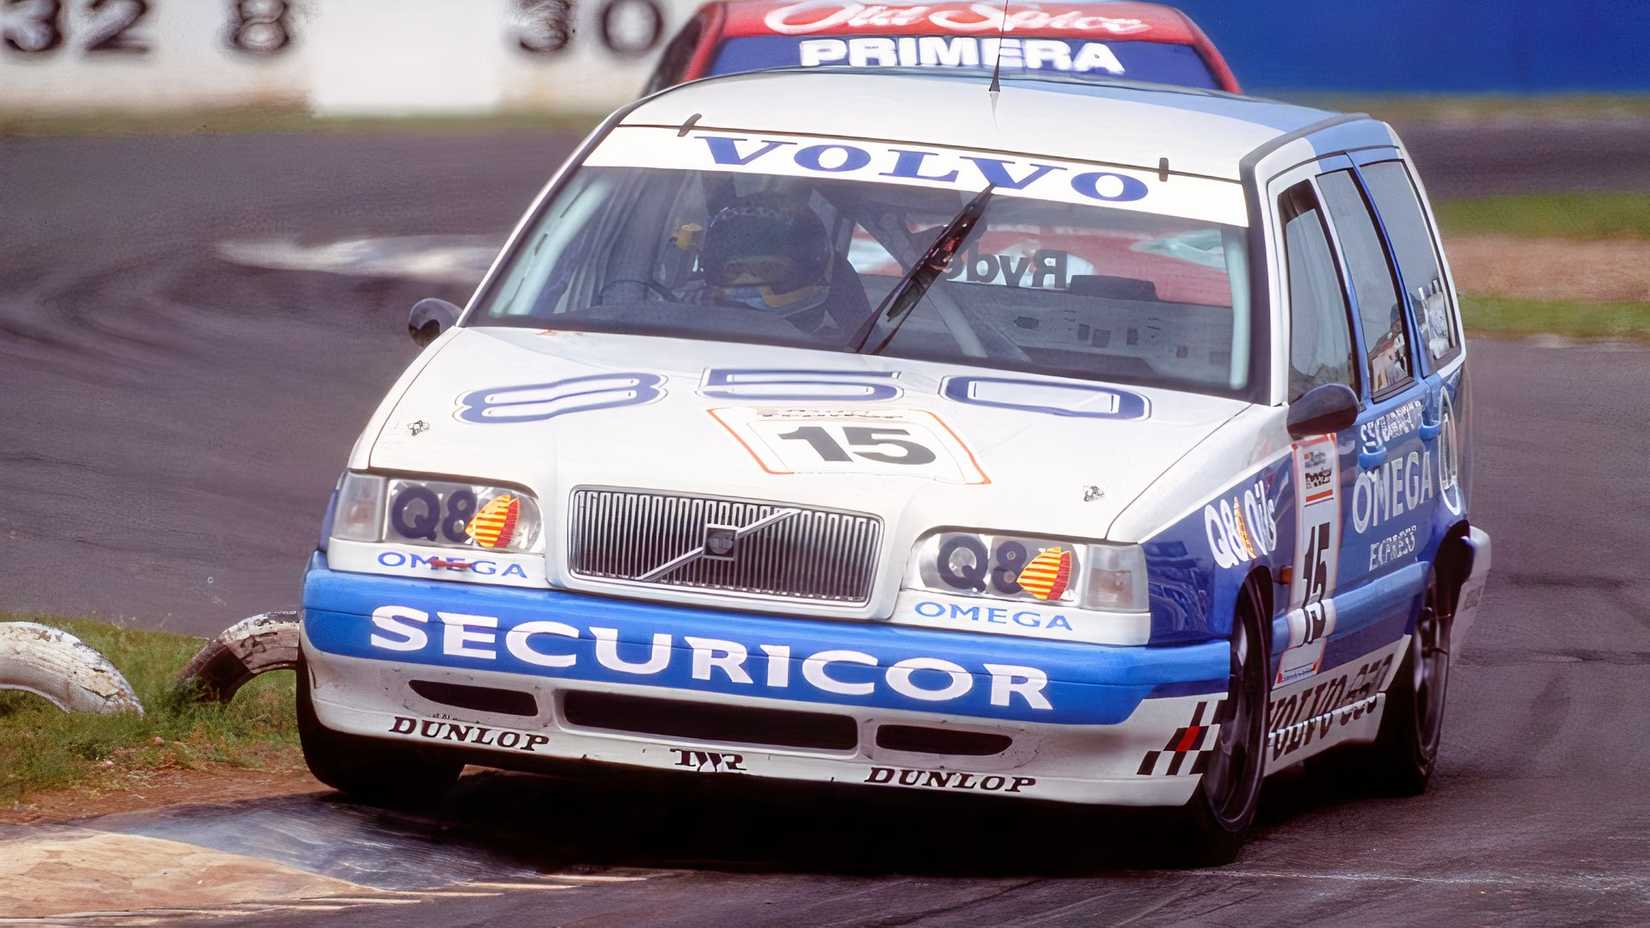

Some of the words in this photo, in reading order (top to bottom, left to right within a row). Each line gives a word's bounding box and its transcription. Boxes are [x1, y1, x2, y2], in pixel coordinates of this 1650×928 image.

[800, 37, 1126, 74] PRIMERA
[695, 135, 1148, 203] VOLVO
[453, 367, 1152, 424] 850
[777, 421, 936, 466] 15
[392, 485, 478, 543] Q8
[1352, 450, 1434, 534] OMEGA
[377, 551, 529, 580] OMEGA
[938, 535, 1029, 595] Q8
[914, 601, 1073, 632] OMEGA
[370, 605, 1054, 711] SECURICOR
[388, 716, 550, 753] DUNLOP
[864, 766, 1037, 794] DUNLOP
